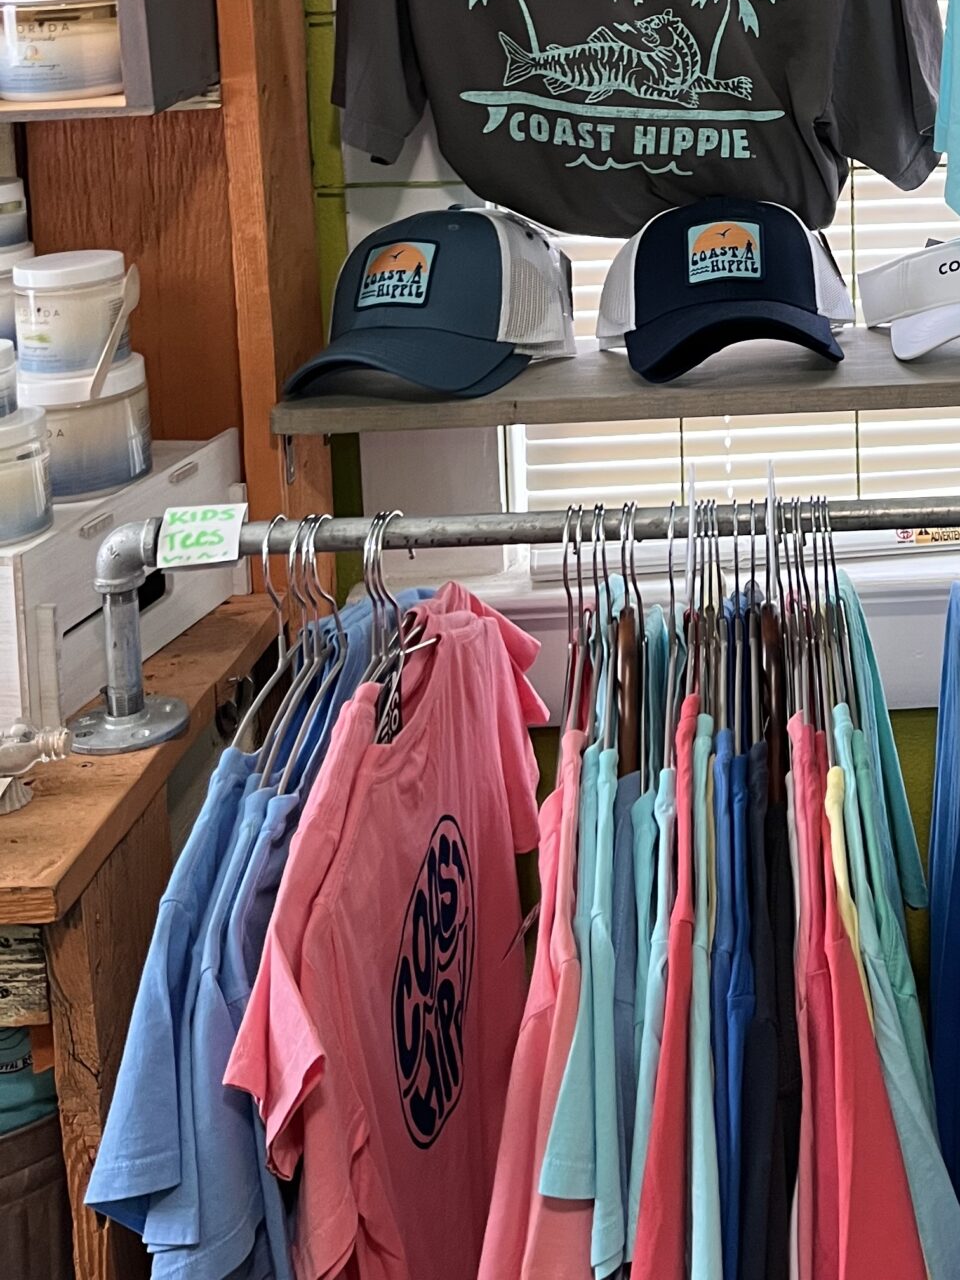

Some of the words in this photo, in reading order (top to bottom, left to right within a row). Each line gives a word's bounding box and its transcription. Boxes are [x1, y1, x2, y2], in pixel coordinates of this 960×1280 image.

[508, 111, 616, 152] COAST
[633, 125, 751, 158] HIPPIE
[691, 246, 739, 266] COAST
[711, 259, 759, 273] HIPPIE
[364, 270, 406, 289] COAST
[376, 284, 424, 299] HIPPIE
[167, 508, 236, 526] KIDS
